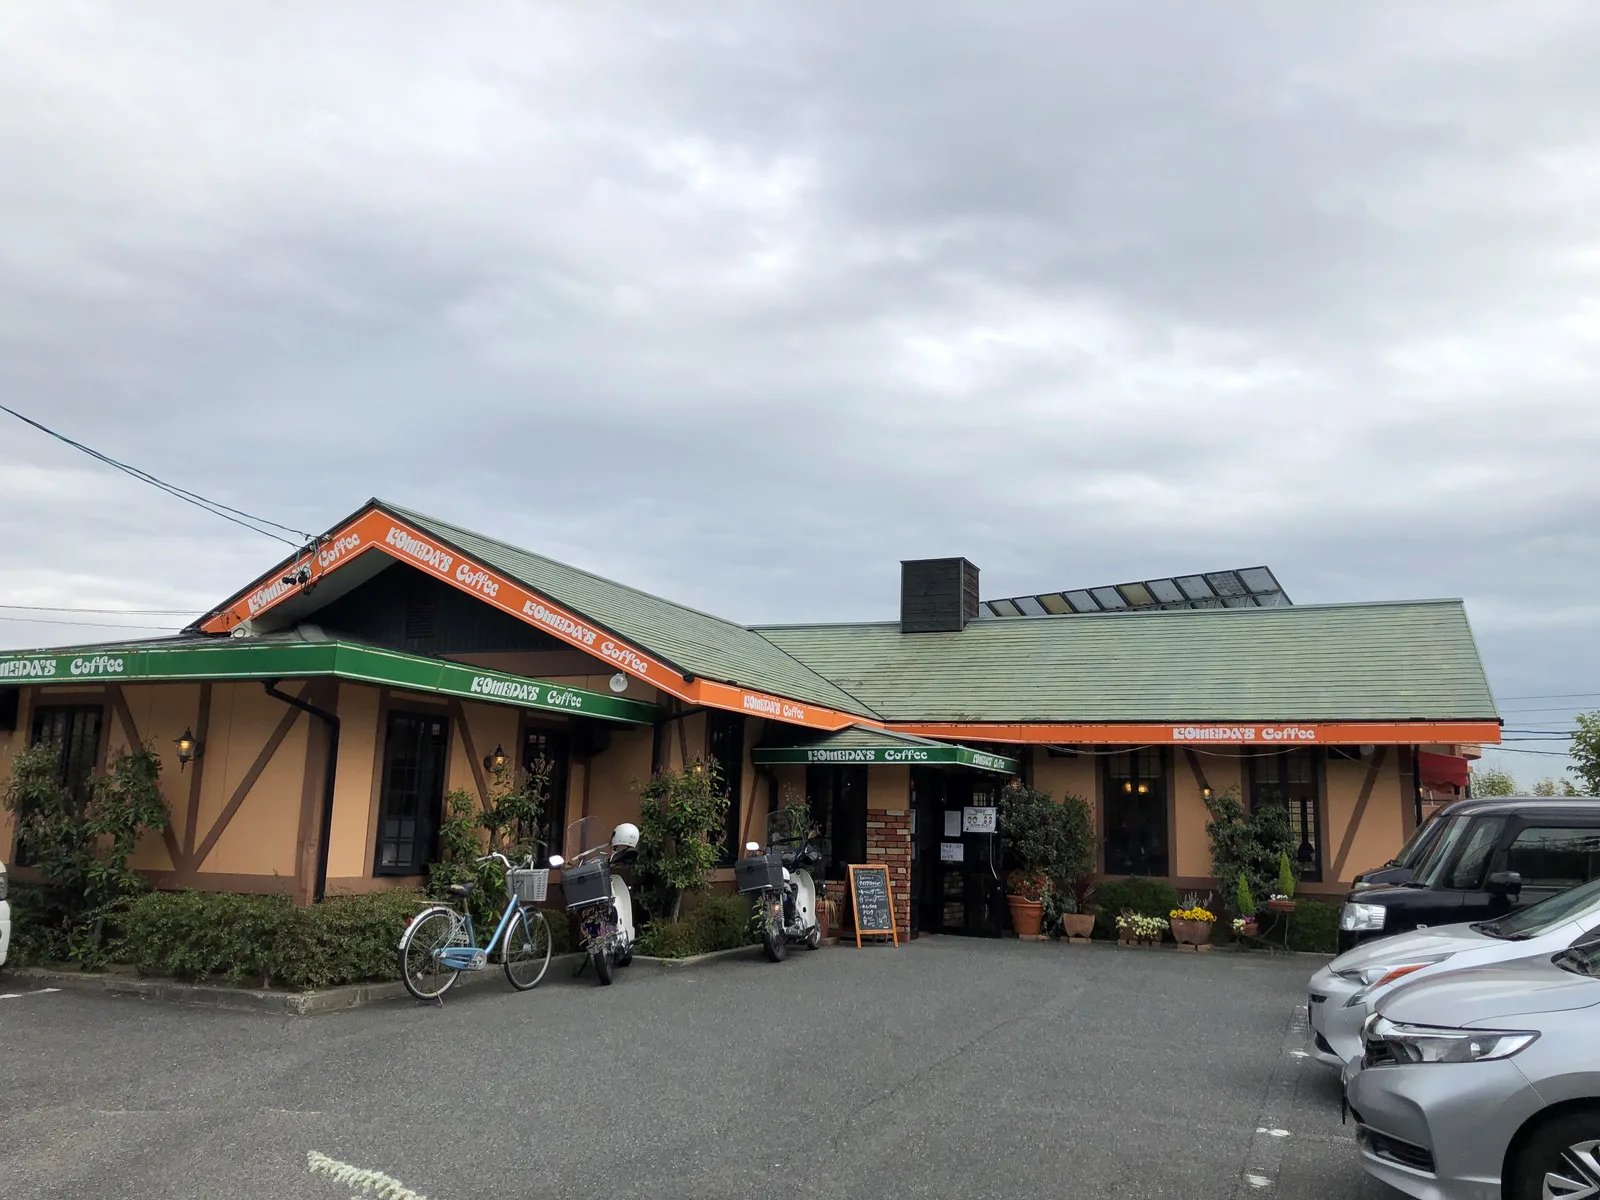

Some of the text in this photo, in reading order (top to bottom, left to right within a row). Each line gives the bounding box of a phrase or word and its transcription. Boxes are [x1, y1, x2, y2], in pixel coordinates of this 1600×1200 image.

[318, 533, 361, 567] Coffee
[385, 527, 499, 597] KOMEDA'S Coffee
[522, 600, 648, 674] KOMEDA'S Coffee
[70, 656, 124, 675] Coffee
[470, 676, 582, 708] KOMEDA'S Coffee
[743, 694, 804, 720] KOMEDA'S Coffee
[1172, 727, 1316, 740] KOMEDA'S Coffee
[807, 750, 928, 761] KOMEDA'S Coffee
